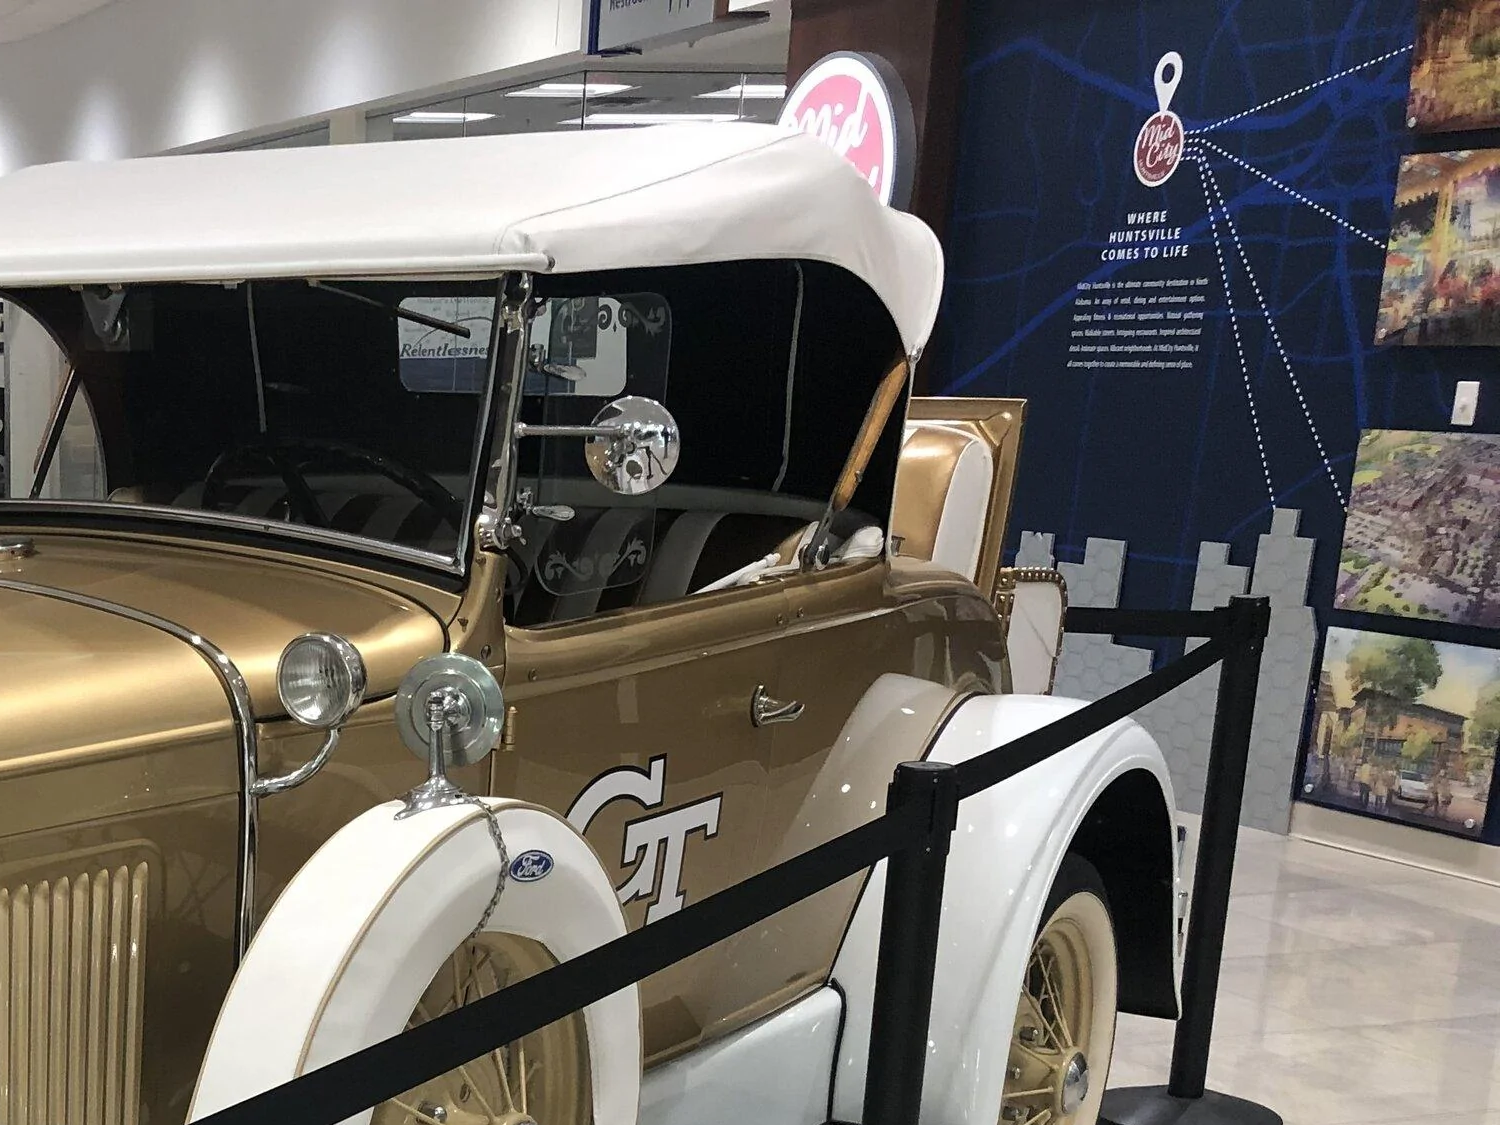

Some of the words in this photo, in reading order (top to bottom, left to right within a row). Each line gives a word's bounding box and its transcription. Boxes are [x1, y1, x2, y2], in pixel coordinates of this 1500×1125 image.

[1141, 118, 1175, 149] Mid
[1146, 142, 1179, 168] City
[1127, 210, 1168, 225] WHERE
[1108, 227, 1182, 243] HUNTSVILLE
[1101, 247, 1139, 261] COMES
[1143, 246, 1159, 259] TO
[1162, 244, 1189, 258] LIFE
[400, 343, 489, 357] Relentlessnes
[517, 854, 546, 877] Ford
